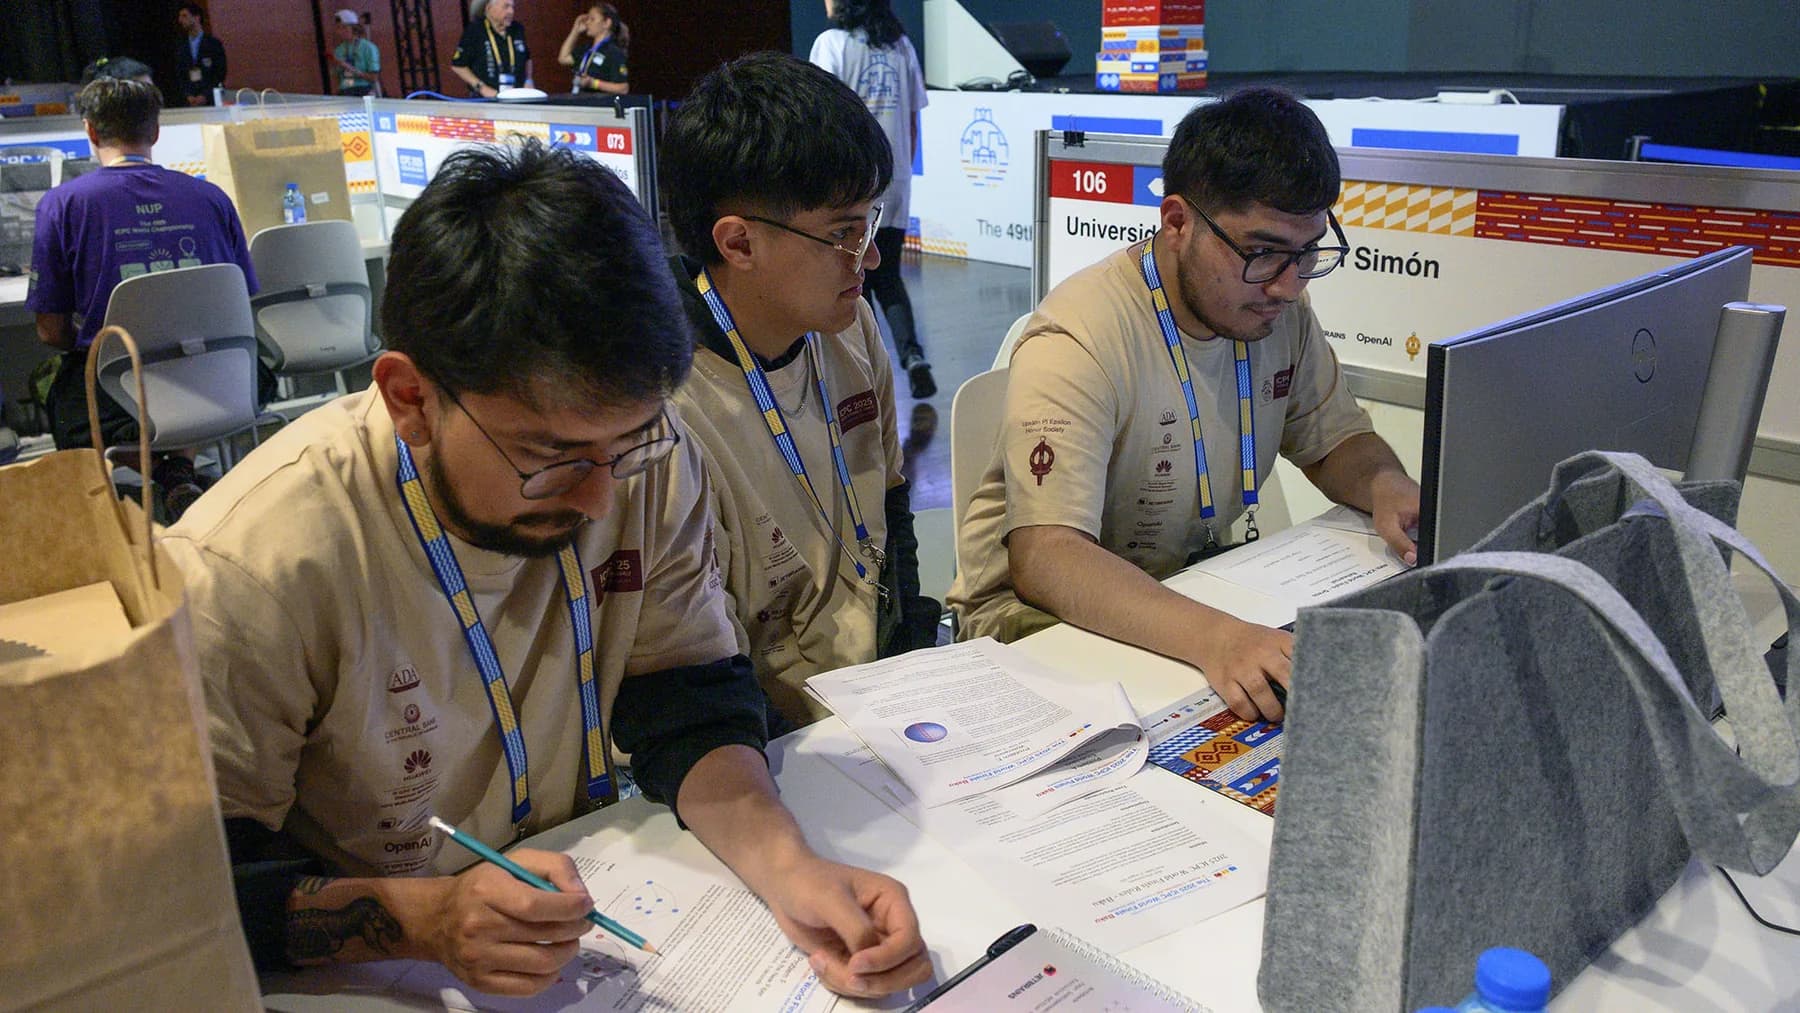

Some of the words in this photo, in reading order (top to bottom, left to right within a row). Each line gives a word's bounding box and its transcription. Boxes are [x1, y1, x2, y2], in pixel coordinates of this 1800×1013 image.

[607, 133, 625, 150] 073
[1072, 170, 1107, 194] 106
[136, 203, 163, 214] NUP
[976, 218, 1002, 237] The
[1066, 215, 1157, 243] Universid
[1355, 246, 1440, 279] Simón
[1322, 330, 1346, 340] RAINS
[1356, 332, 1393, 346] OpenAI
[391, 667, 418, 687] ADA
[384, 837, 432, 854] OpenAI
[1196, 877, 1211, 886] The
[1138, 895, 1161, 909] World
[1094, 912, 1115, 924] Baku
